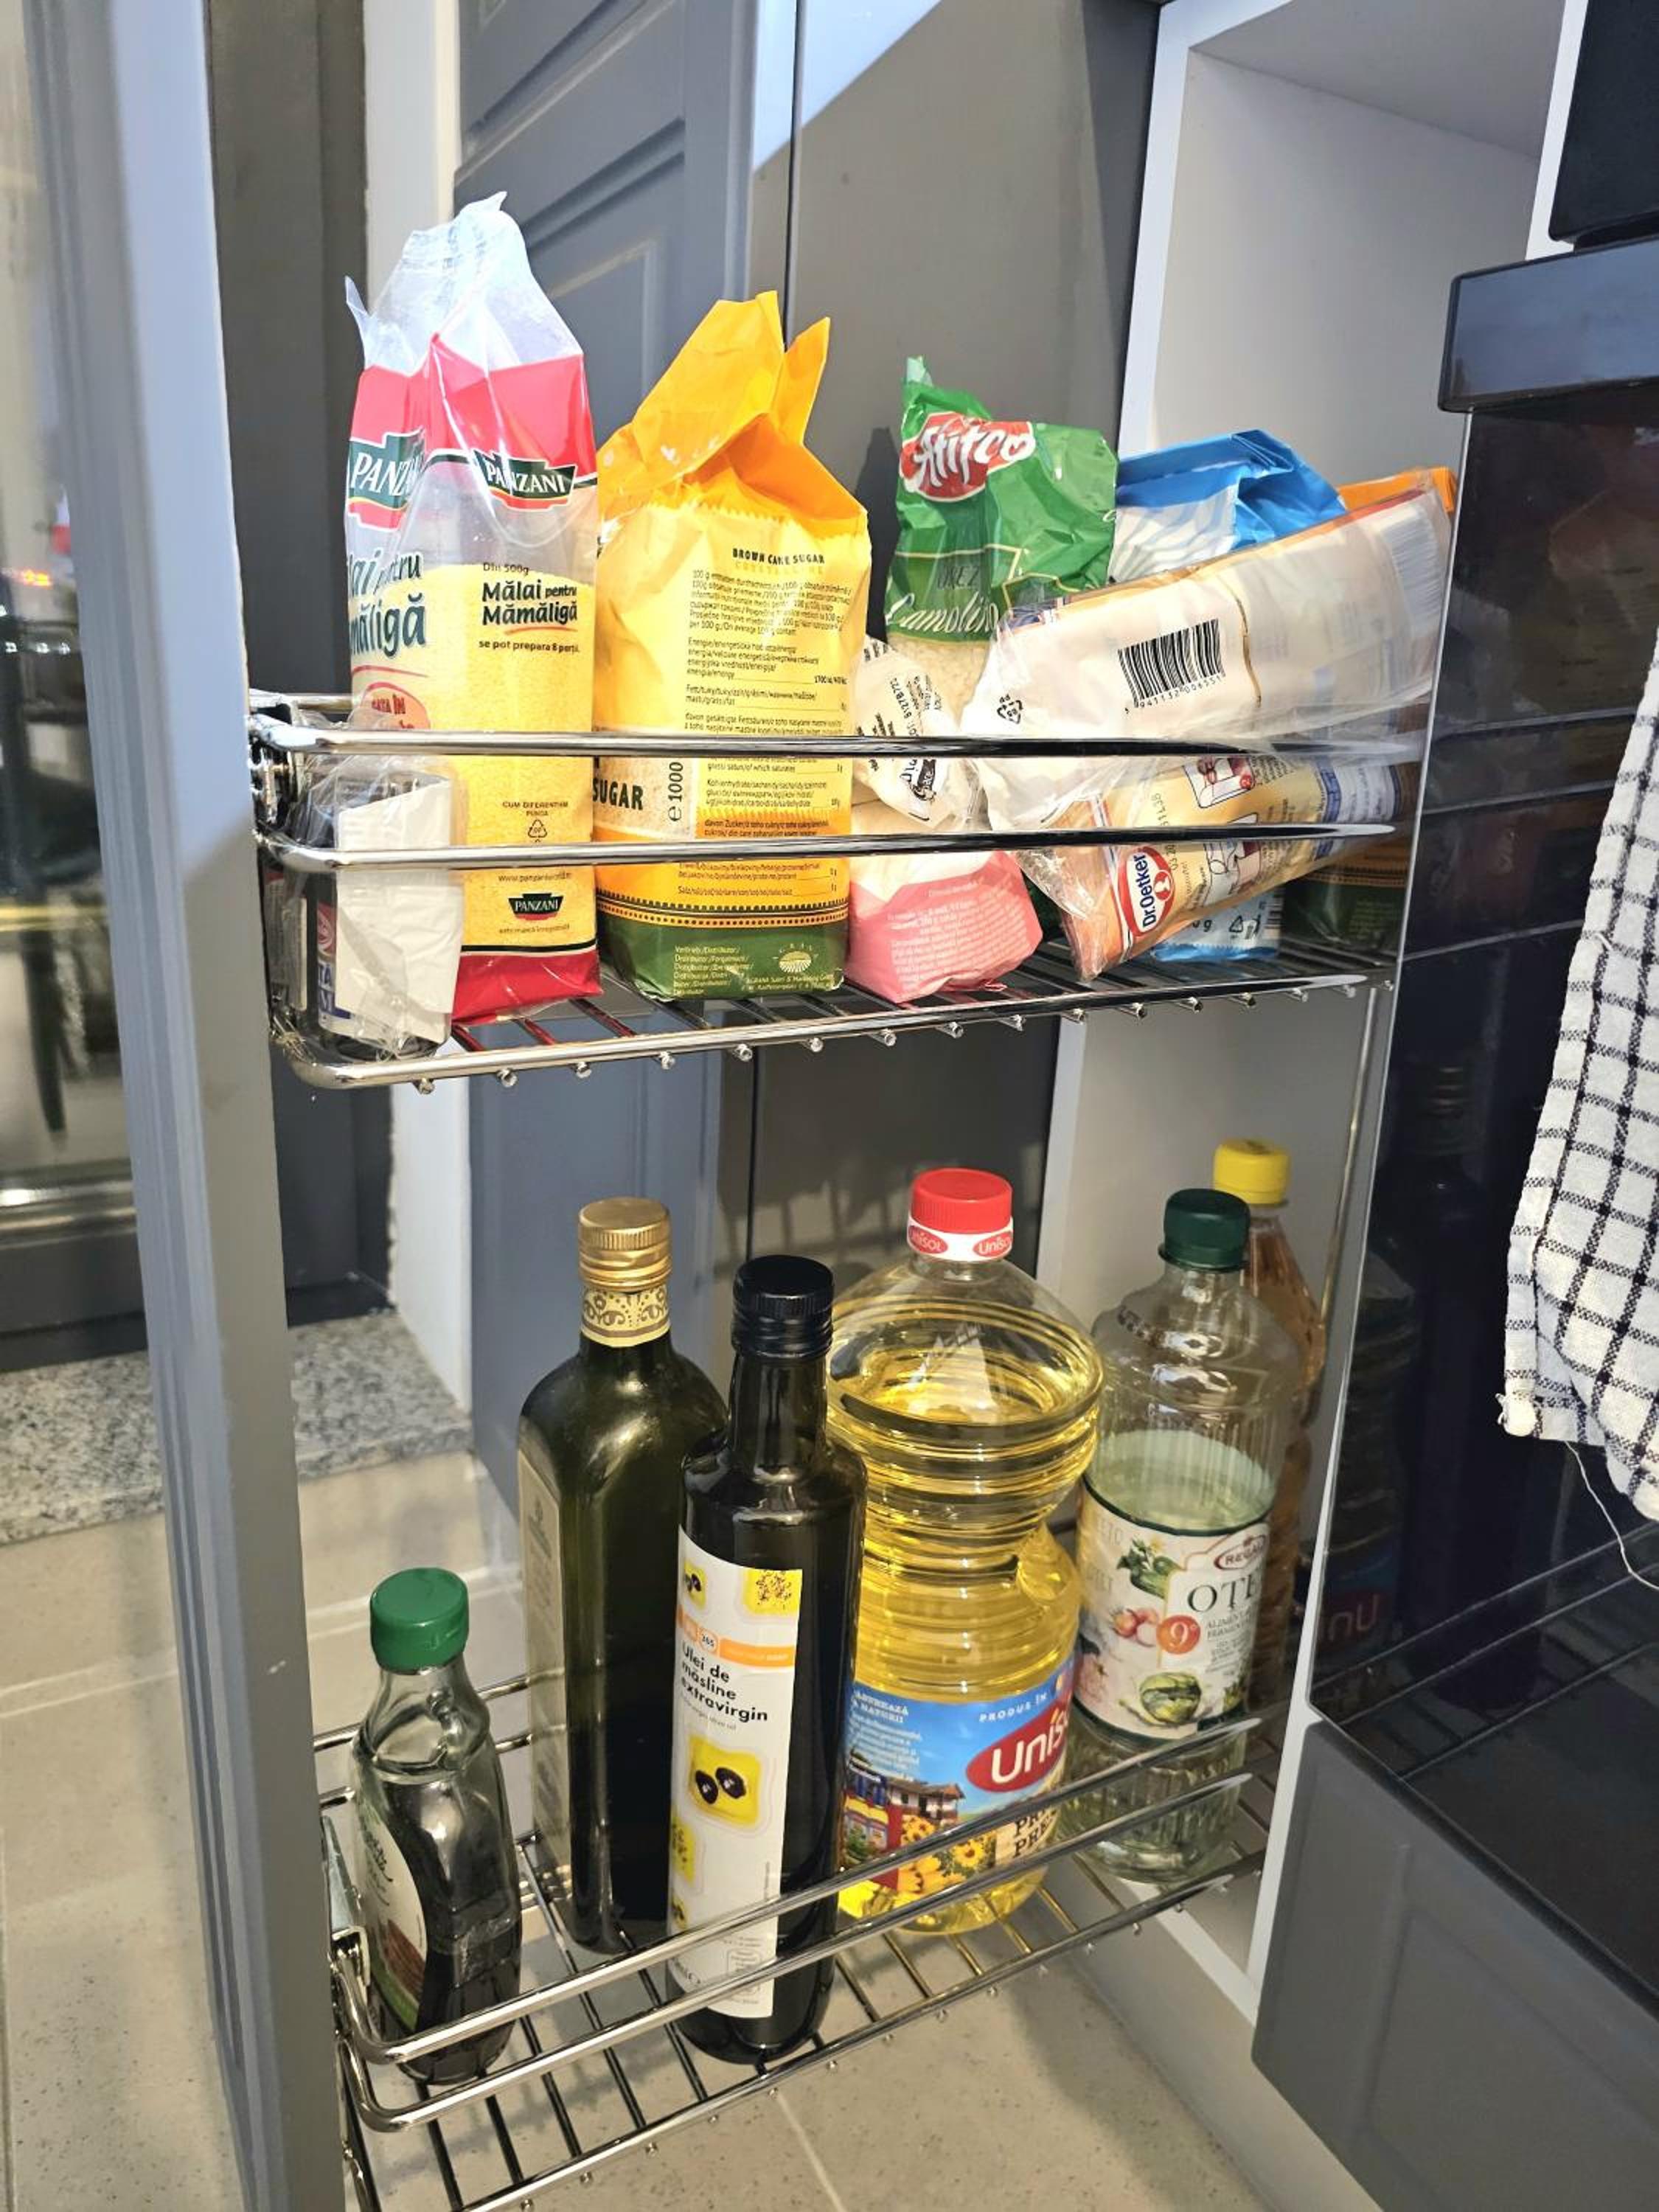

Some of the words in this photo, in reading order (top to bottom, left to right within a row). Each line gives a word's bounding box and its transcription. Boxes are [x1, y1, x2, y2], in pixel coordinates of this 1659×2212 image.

[485, 460, 566, 493] PANZANI
[732, 548, 765, 563] BROWN
[768, 554, 790, 566] CANE
[793, 554, 825, 564] SUGAR
[482, 578, 542, 602] Mălai
[482, 601, 577, 625] Mămăligă
[493, 641, 511, 649] pot
[512, 641, 551, 651] prepara
[592, 777, 644, 810] SUGAR
[668, 762, 684, 802] 1000
[1133, 852, 1157, 928] Dr.Oetker
[515, 899, 558, 912] PANZANI
[978, 1235, 1012, 1256] Uniso
[682, 1640, 705, 1672] Ulei
[709, 1663, 730, 1683] de
[681, 1677, 768, 1723] extravirgin
[979, 1701, 1032, 1723] PRODUS
